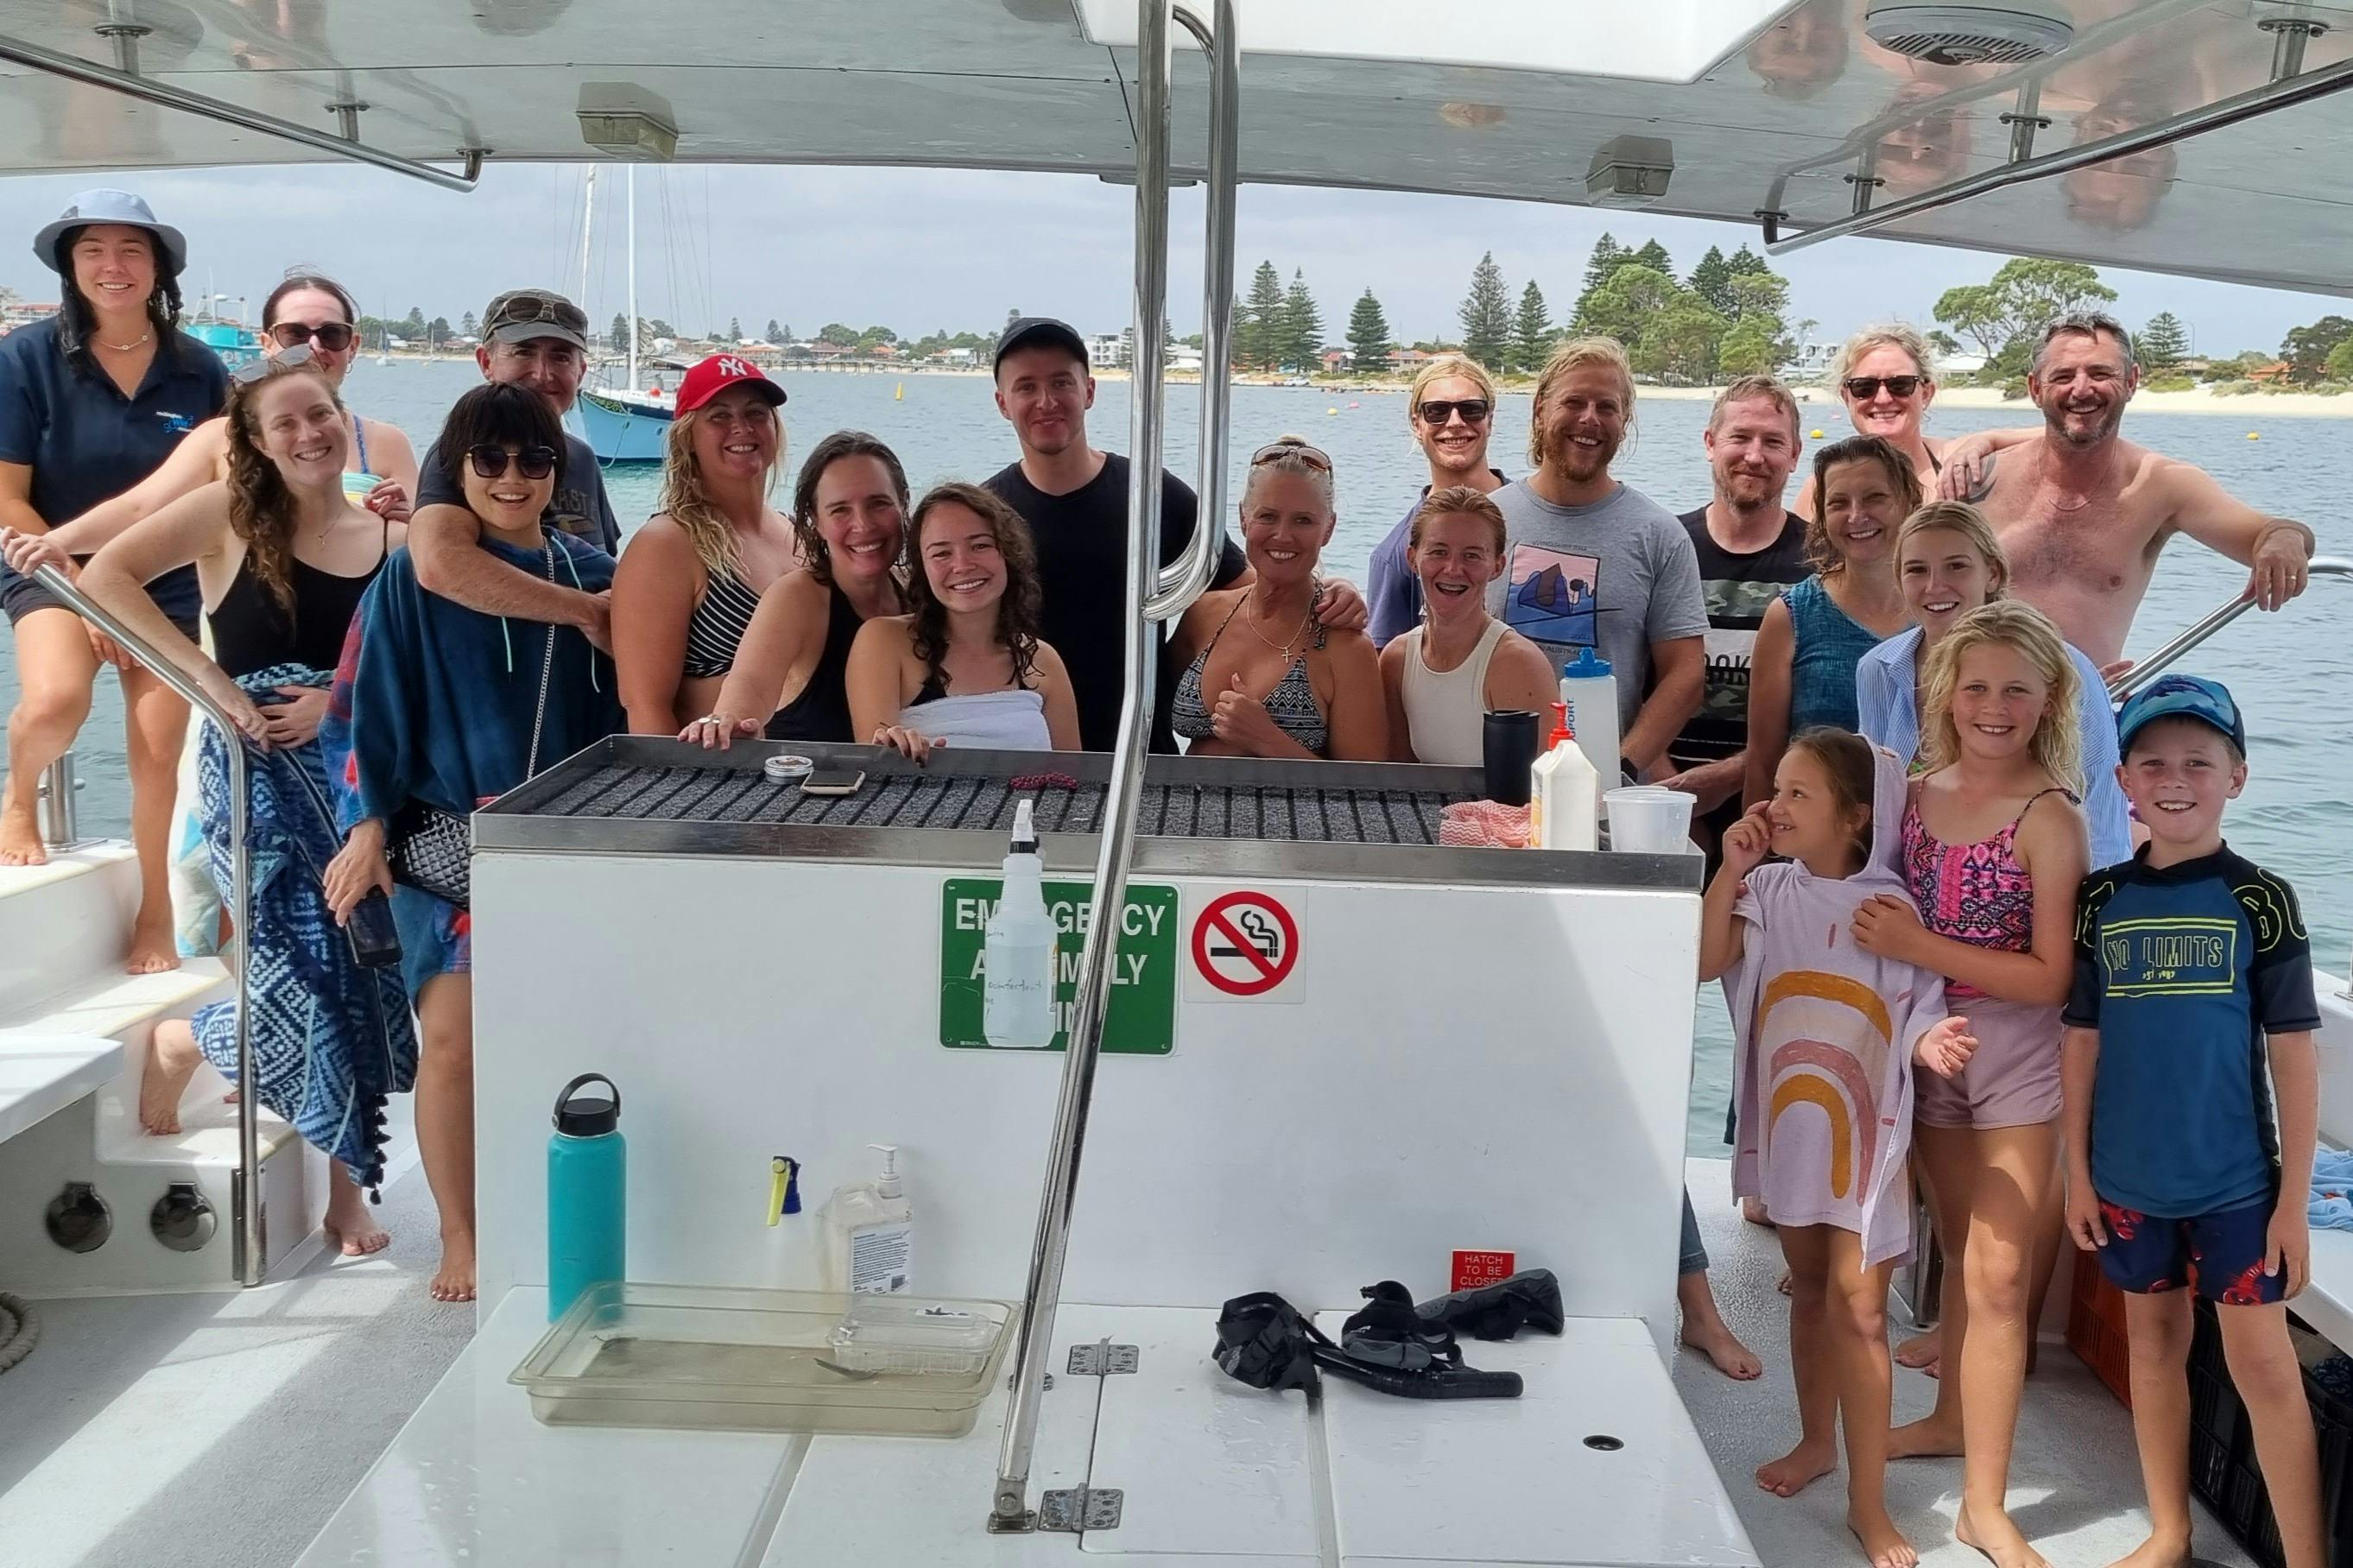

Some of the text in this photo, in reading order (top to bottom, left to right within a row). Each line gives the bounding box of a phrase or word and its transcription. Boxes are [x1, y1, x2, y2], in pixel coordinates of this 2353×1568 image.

[956, 898, 1167, 936] EMGECY
[970, 949, 1148, 985] AMLY
[2107, 935, 2223, 971] NO LIMITS
[1464, 1255, 1503, 1265] HATCH
[1465, 1265, 1502, 1276] TO BE
